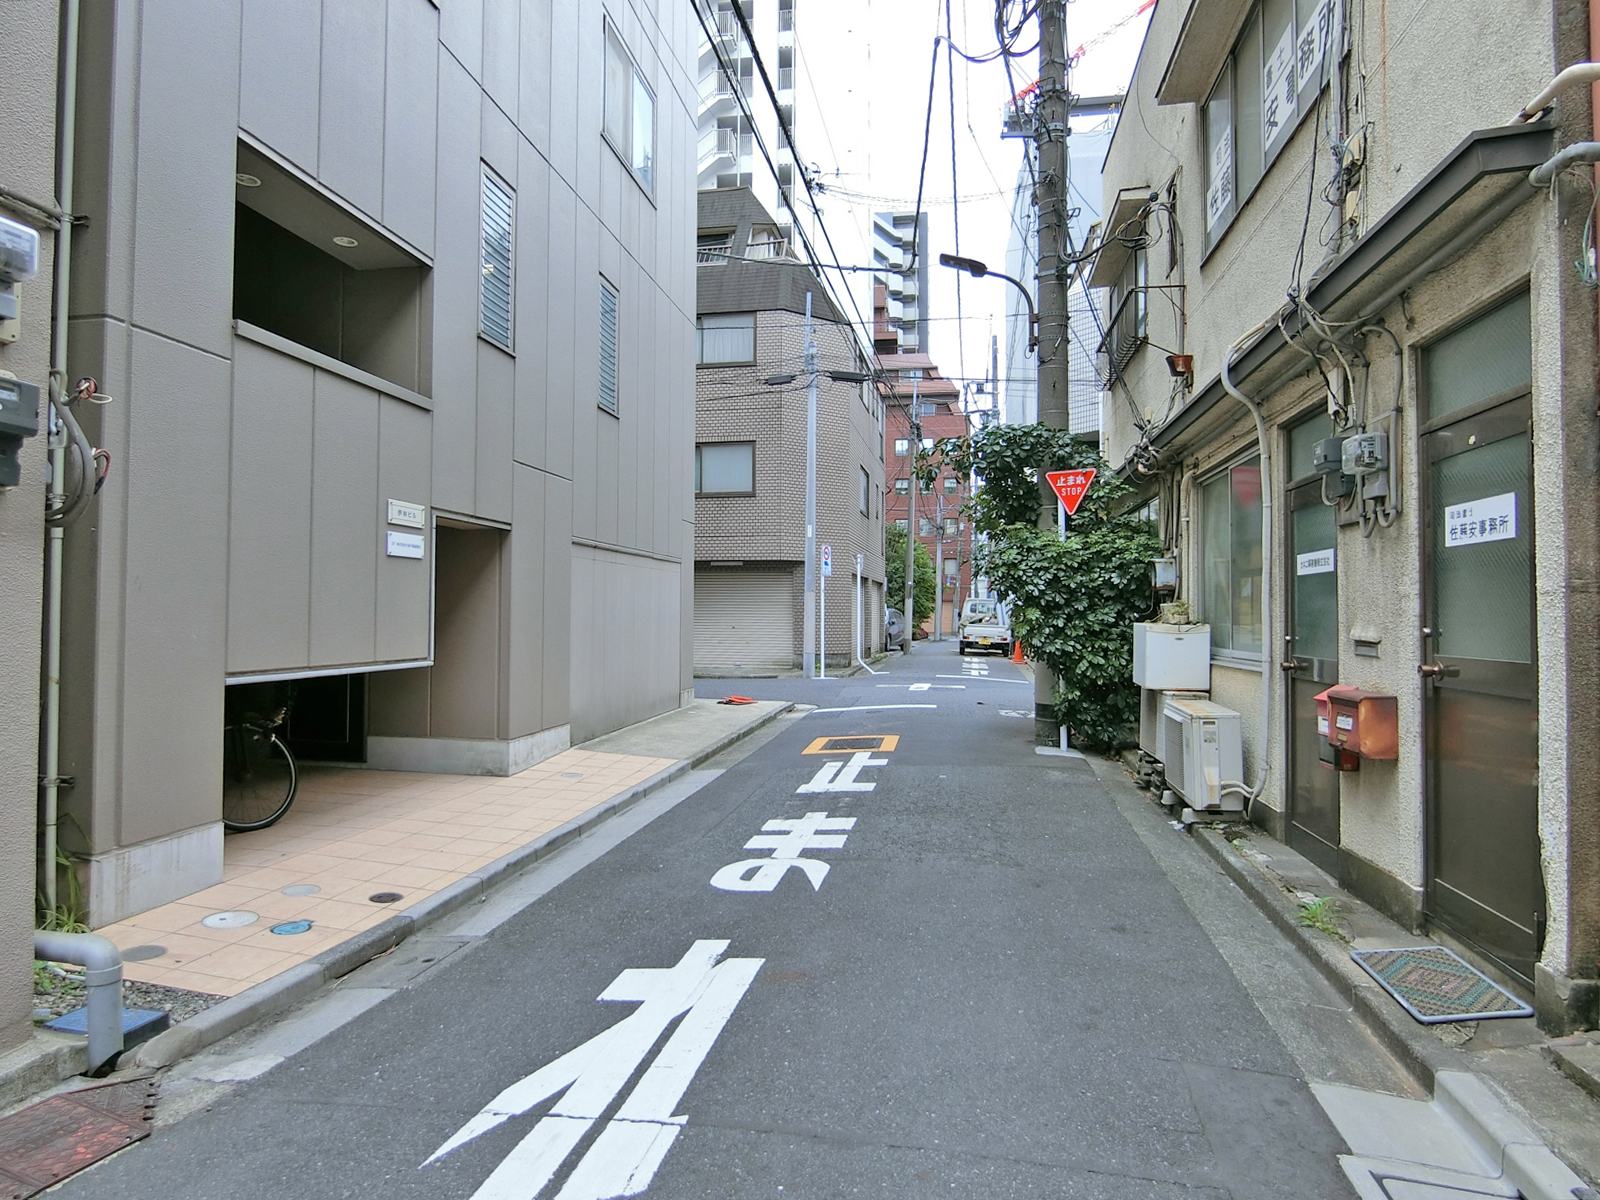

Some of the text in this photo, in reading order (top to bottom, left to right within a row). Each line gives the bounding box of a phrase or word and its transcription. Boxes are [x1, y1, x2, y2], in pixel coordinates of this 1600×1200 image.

[1056, 475, 1086, 486] 止まれ
[1061, 487, 1082, 496] STOP
